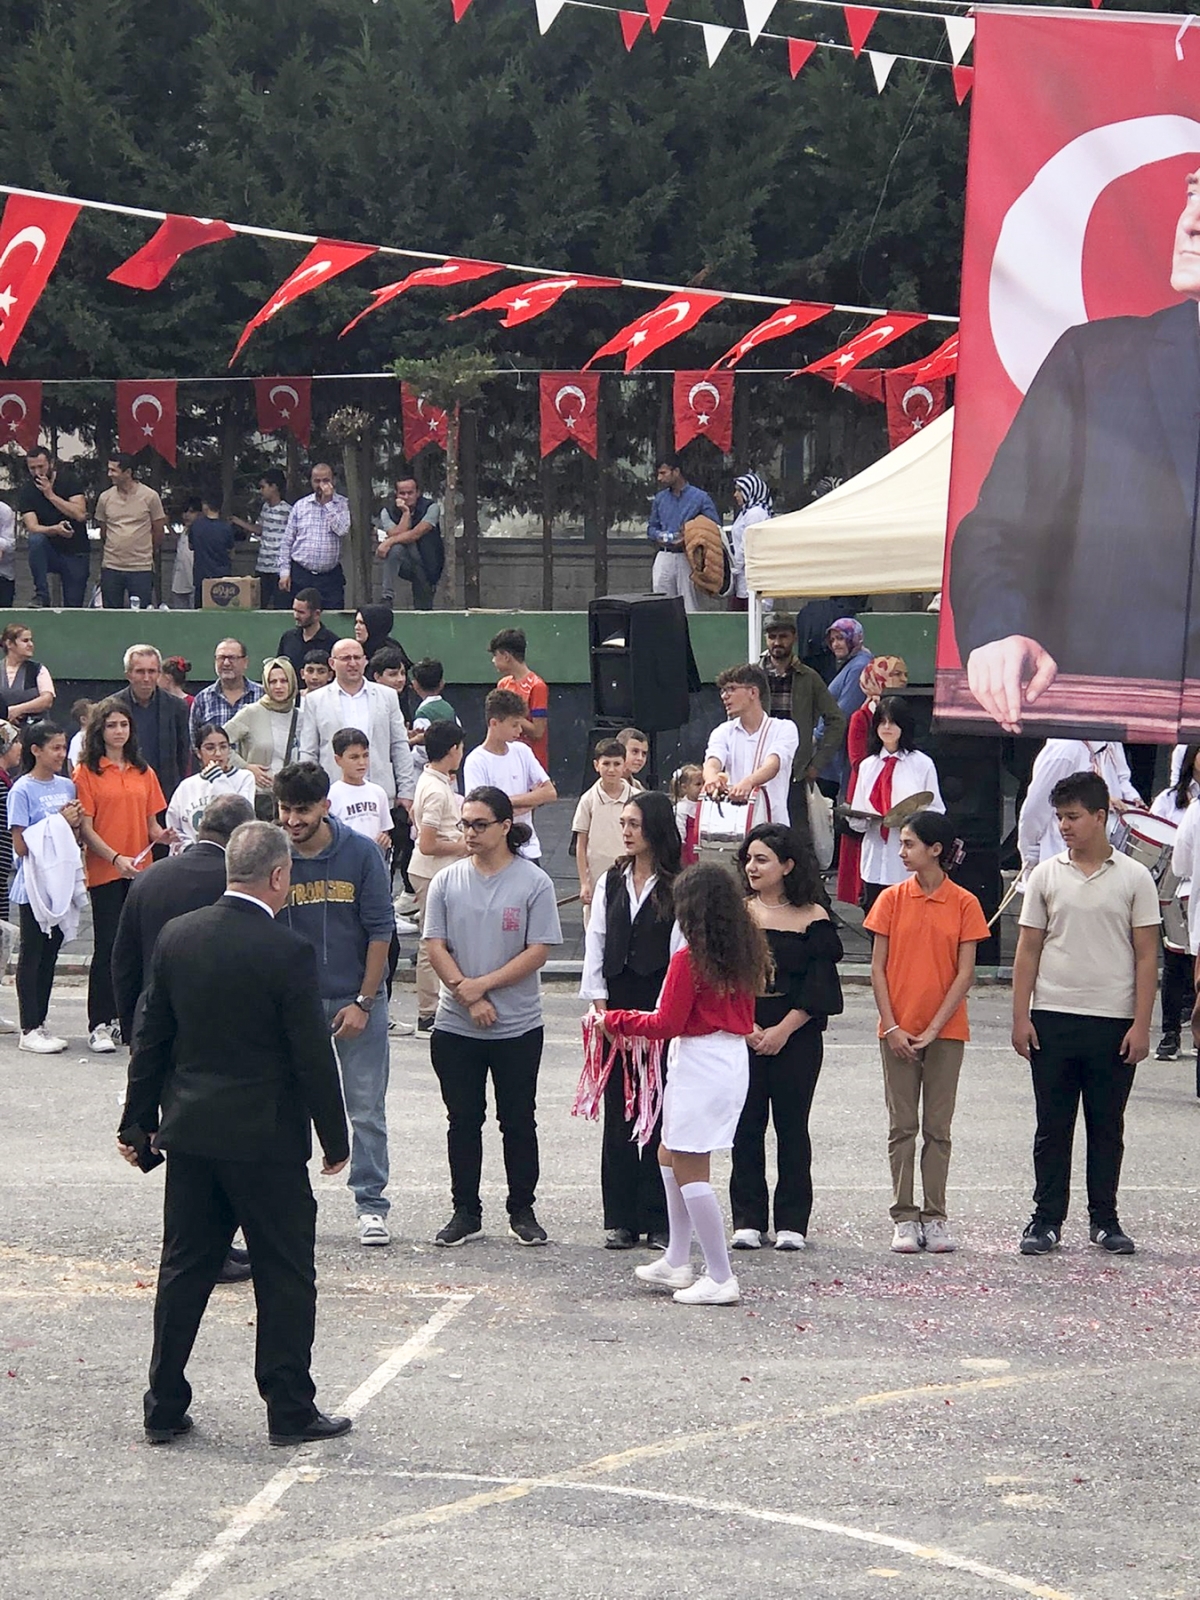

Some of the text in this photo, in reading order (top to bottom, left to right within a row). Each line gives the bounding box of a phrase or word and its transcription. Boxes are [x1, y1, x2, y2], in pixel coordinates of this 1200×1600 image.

[181, 795, 216, 823] CALIF
[346, 801, 378, 816] NEVER
[288, 880, 356, 907] TRONGER
